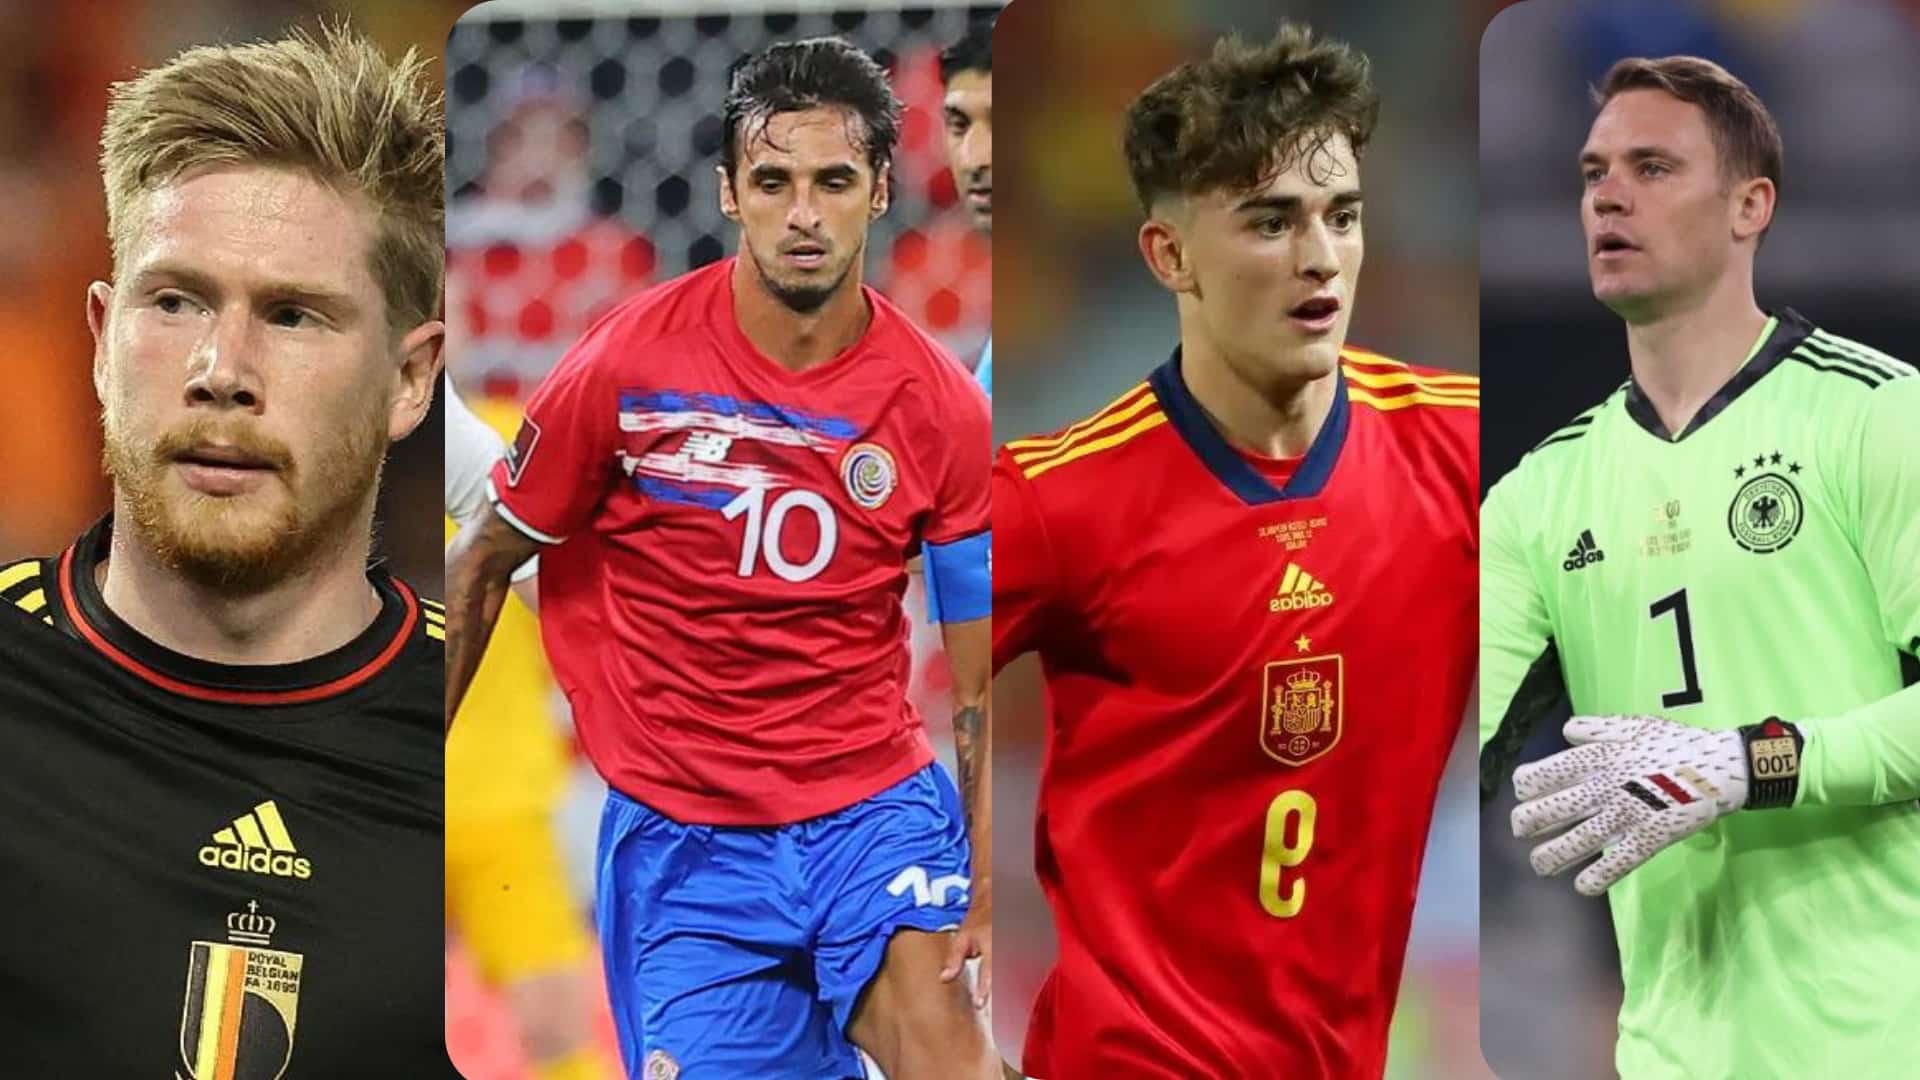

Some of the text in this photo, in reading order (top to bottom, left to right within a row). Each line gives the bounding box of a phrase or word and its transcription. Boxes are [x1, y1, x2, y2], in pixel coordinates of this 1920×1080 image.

[720, 485, 838, 582] 10
[1563, 549, 1604, 572] adas
[1650, 588, 1704, 708] 1
[1757, 754, 1794, 774] 100
[199, 843, 311, 879] adidas
[248, 952, 287, 968] ROYAL
[246, 964, 299, 981] BELGIAN
